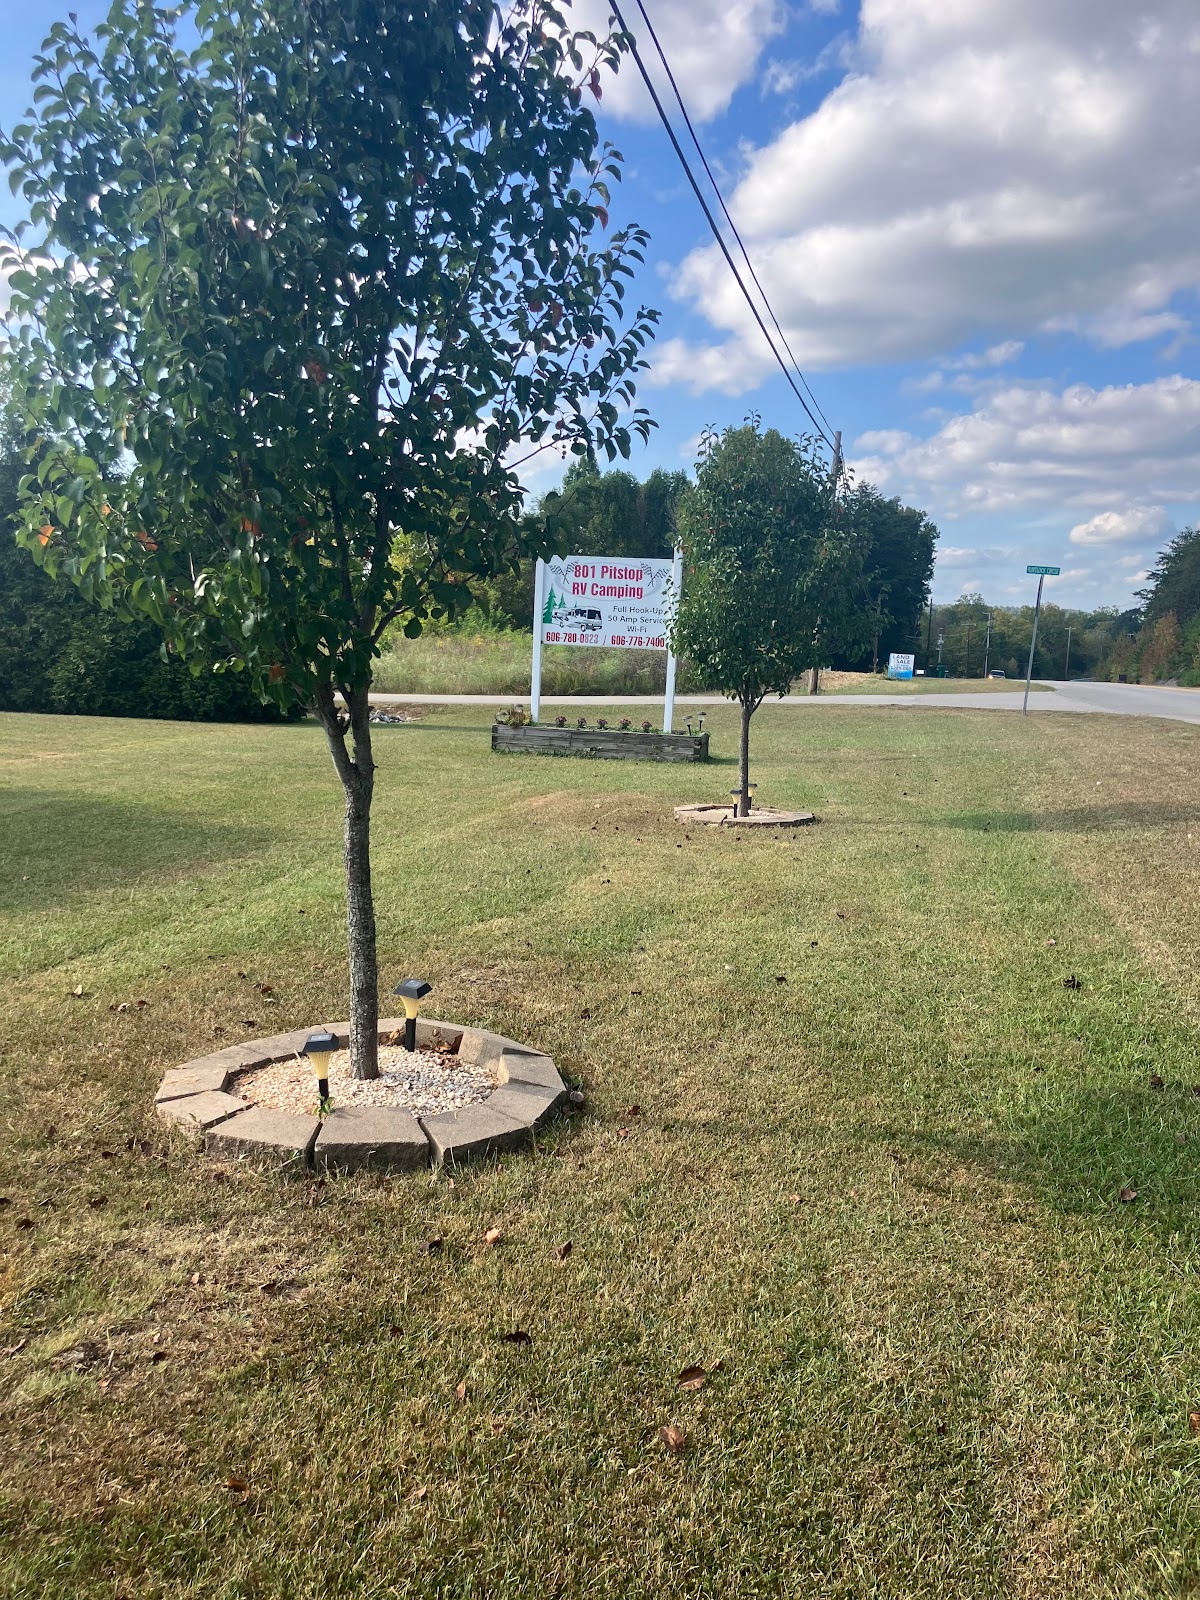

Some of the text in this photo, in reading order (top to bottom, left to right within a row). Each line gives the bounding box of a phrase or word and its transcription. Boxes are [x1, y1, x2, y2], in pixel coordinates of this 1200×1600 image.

[574, 565, 643, 582] 801 Pitstop
[572, 583, 643, 599] RV Camping
[630, 607, 663, 615] Hook-Up
[620, 616, 638, 624] Amp
[546, 632, 665, 647] 606-780-0823 / 606-776-7400
